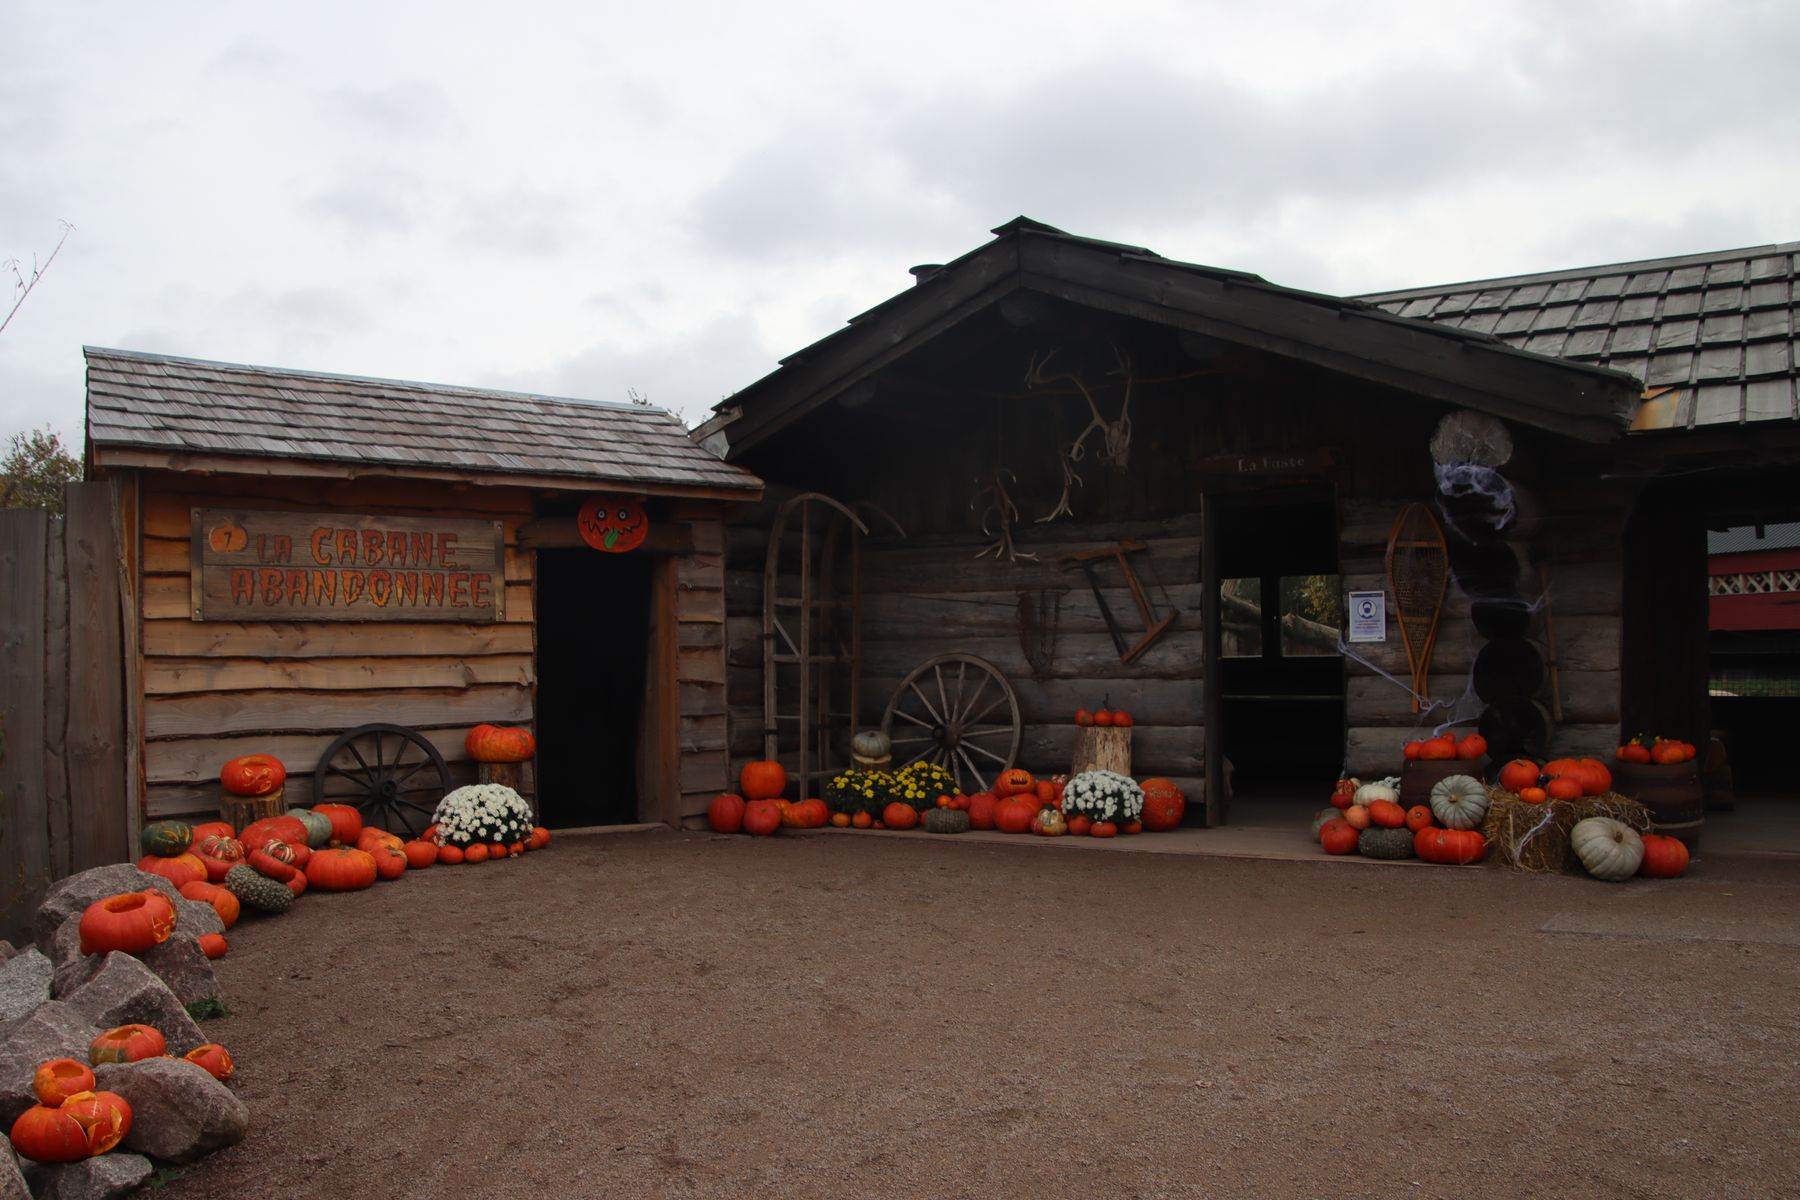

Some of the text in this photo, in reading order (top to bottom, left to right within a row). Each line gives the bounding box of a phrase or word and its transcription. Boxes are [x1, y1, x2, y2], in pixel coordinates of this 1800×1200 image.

[1238, 459, 1257, 472] La
[223, 530, 233, 550] 7
[257, 526, 459, 567] LA CABANE
